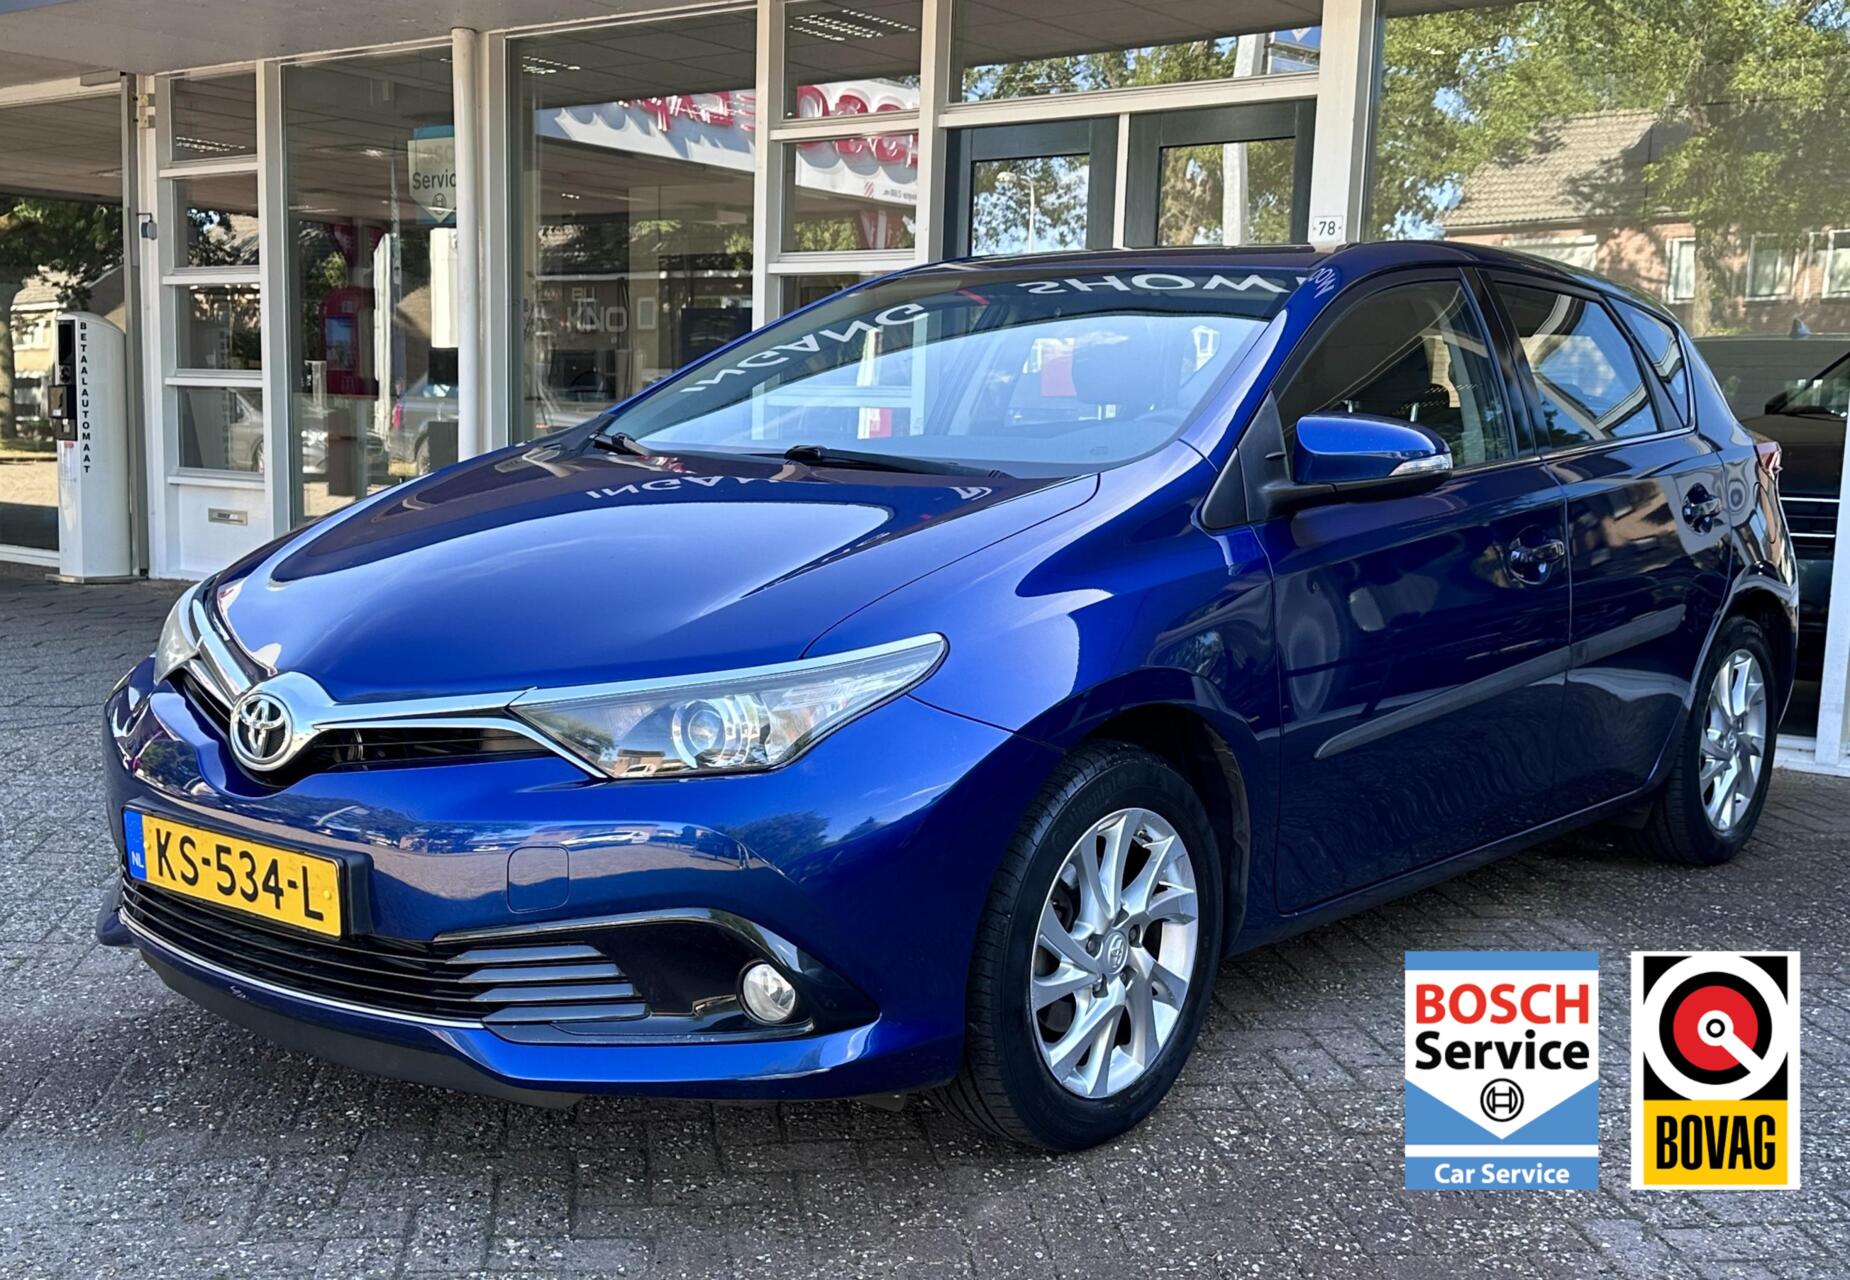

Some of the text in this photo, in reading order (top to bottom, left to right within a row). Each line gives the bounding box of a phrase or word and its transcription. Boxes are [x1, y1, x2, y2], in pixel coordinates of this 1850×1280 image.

[412, 168, 456, 190] Servic
[1319, 220, 1336, 236] 78
[80, 322, 91, 474] BETAALAUTOMAAT
[131, 828, 324, 921] NL KS-534-L
